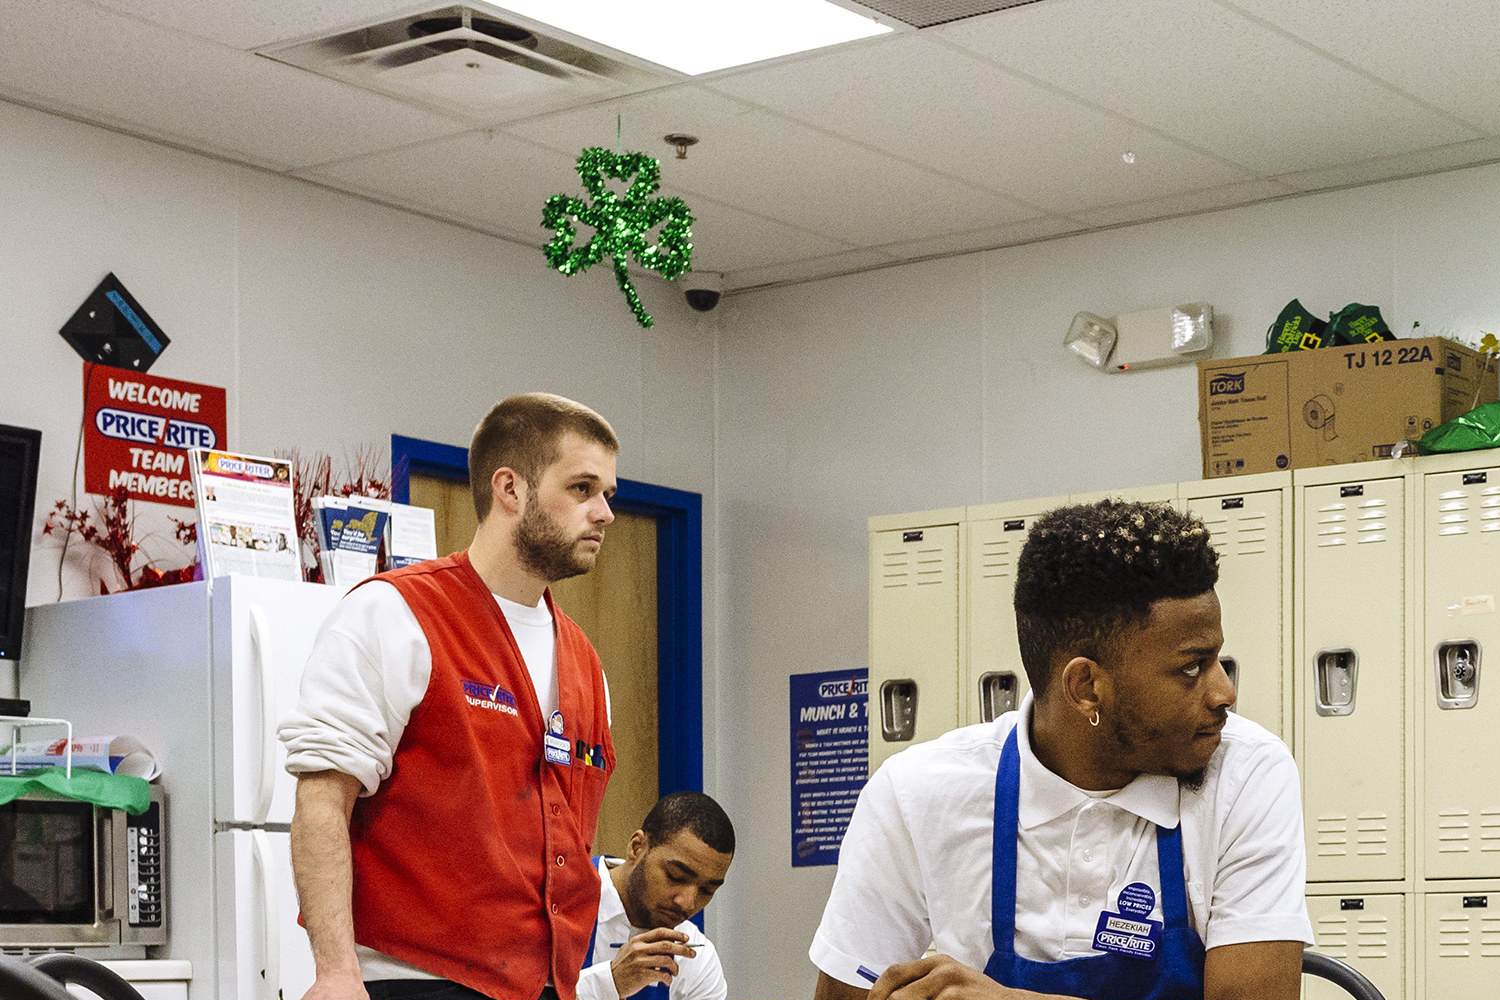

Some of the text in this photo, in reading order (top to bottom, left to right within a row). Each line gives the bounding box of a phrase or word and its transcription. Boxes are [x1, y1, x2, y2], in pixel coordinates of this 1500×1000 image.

[1344, 345, 1433, 369] TJ 12 22A
[1211, 379, 1243, 393] TORK
[108, 378, 201, 413] WELCOME
[102, 412, 211, 448] PRICE RITE
[129, 448, 185, 475] TEAM
[220, 460, 271, 477] PRICE RITER
[463, 682, 491, 697] PRICE
[821, 681, 868, 696] PRICE RIT
[465, 695, 518, 717] SUPERVISOR
[800, 703, 846, 722] MUNCH
[848, 703, 858, 718] &
[1133, 902, 1152, 910] PRICES
[1109, 920, 1149, 933] HEZEKIAH
[1100, 933, 1151, 950] PRICE RITE
